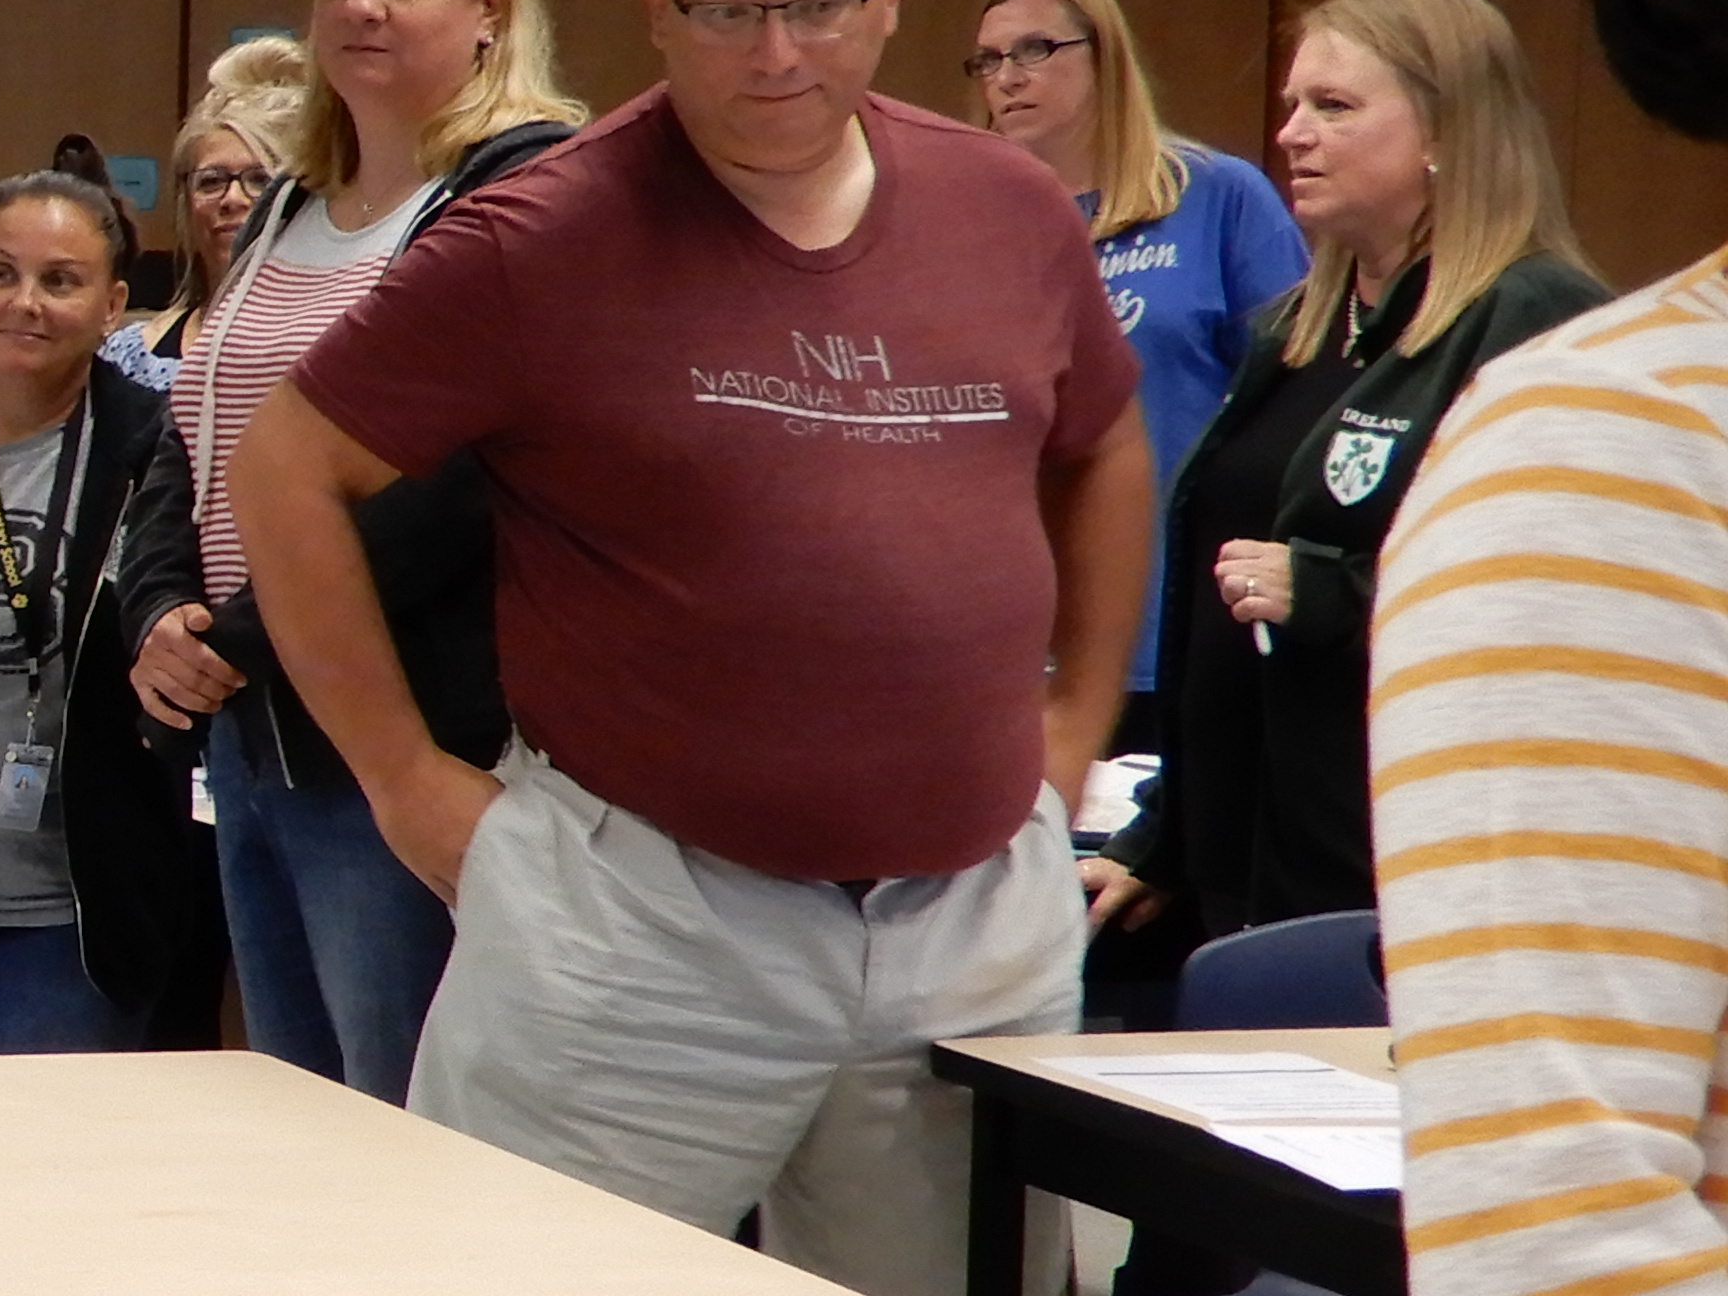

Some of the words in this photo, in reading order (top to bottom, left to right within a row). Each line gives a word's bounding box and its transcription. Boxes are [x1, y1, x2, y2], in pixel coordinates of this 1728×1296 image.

[792, 330, 891, 381] NIH
[865, 383, 1004, 413] INSTITUTES
[784, 418, 823, 436] OF
[843, 425, 941, 444] HEALTH
[1340, 407, 1411, 432] IRELAND
[0, 548, 22, 587] School
